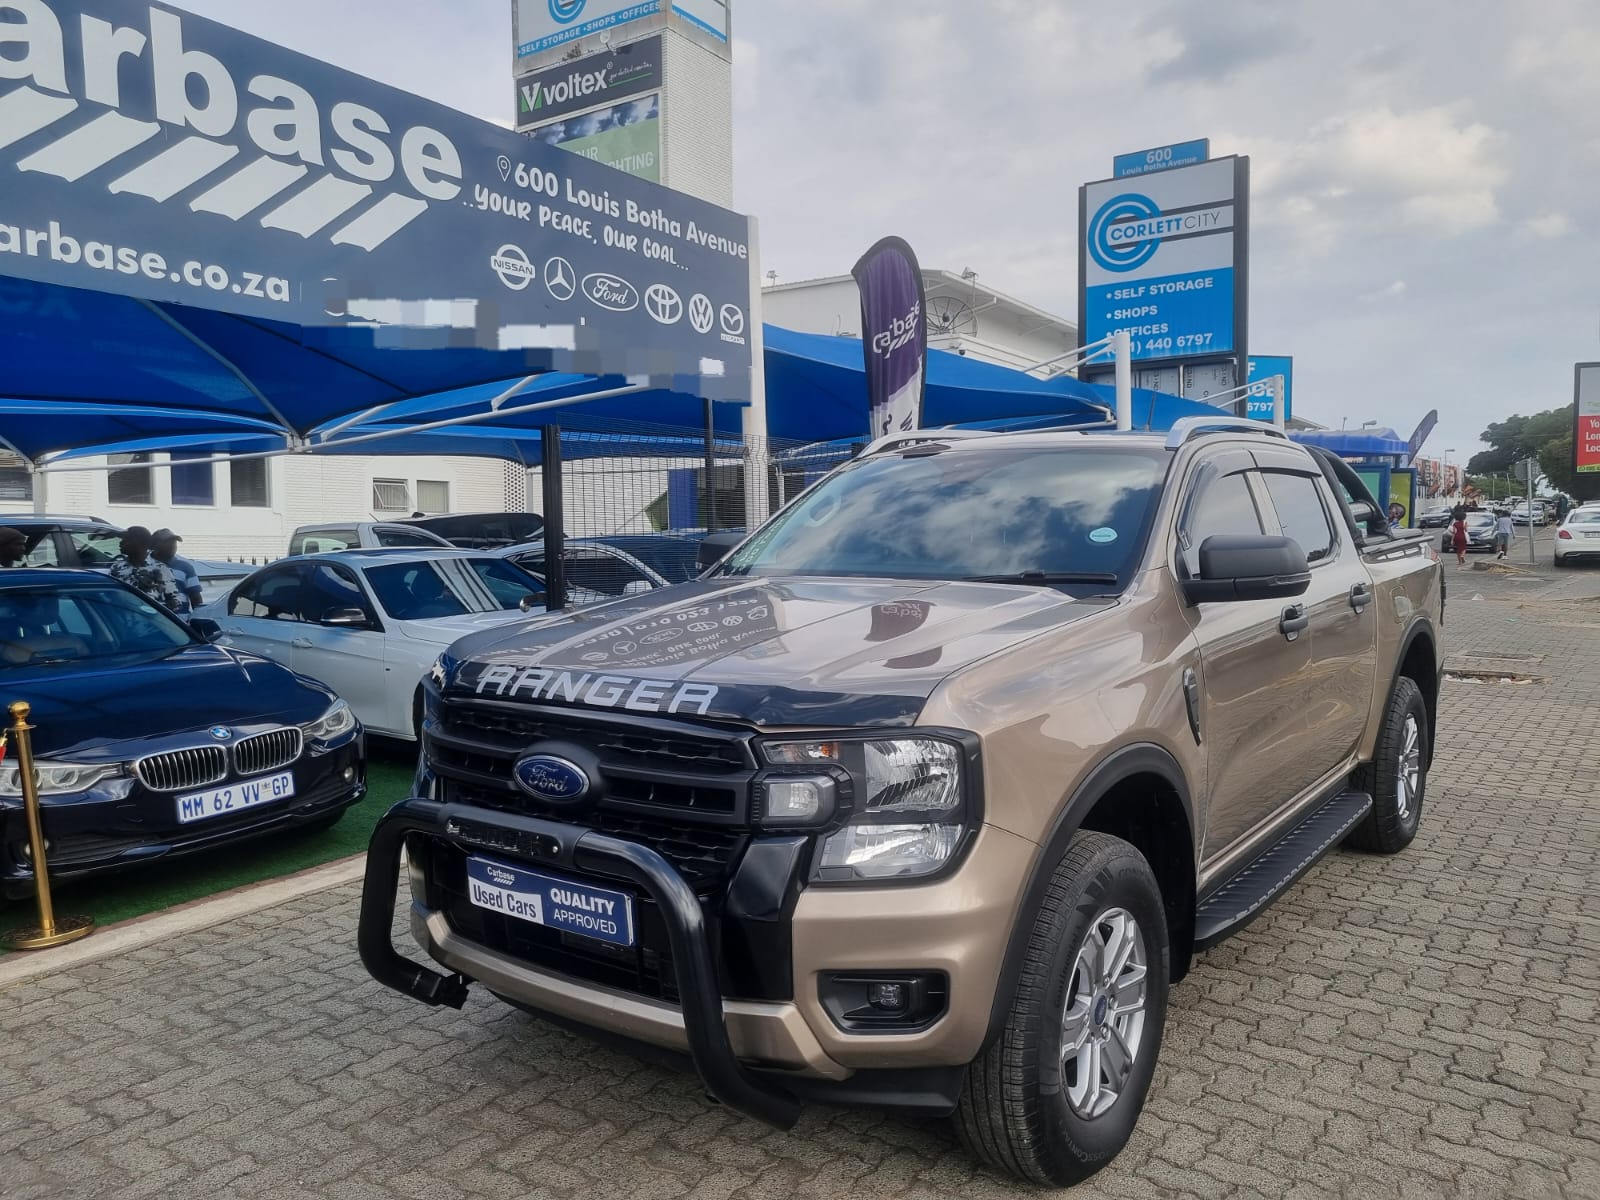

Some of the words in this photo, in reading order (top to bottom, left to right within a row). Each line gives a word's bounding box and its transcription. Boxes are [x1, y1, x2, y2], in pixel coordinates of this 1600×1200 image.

[521, 44, 540, 55] SELF
[543, 28, 580, 48] STORAGE
[586, 15, 616, 32] SHOPS
[622, 2, 660, 20] OFFICES
[543, 69, 608, 106] voltex
[1122, 167, 1142, 176] Louis
[1144, 163, 1166, 172] Botha
[1168, 156, 1198, 167] Avenue
[1146, 148, 1172, 164] 600
[514, 162, 559, 198] 600
[566, 178, 620, 219] Louis
[626, 200, 681, 238] Botha
[686, 221, 748, 260] Avenue
[539, 204, 598, 245] PEACE,
[603, 225, 638, 253] OUR
[492, 258, 534, 276] NISSAN
[593, 278, 629, 307] Ford
[1114, 286, 1145, 300] SELF
[1149, 277, 1213, 295] STORAGE
[1114, 305, 1158, 320] SHOPS
[1145, 337, 1172, 351] 440
[1176, 333, 1213, 347] 6797
[476, 665, 719, 715] RANGER
[528, 764, 568, 793] Ford
[182, 796, 204, 819] MM
[213, 790, 234, 811] 62
[242, 783, 260, 804] VV
[272, 775, 289, 796] GP
[487, 866, 516, 882] Carbase
[473, 883, 503, 913] Used
[507, 894, 537, 919] Cars
[550, 887, 615, 916] QUALITY
[554, 908, 617, 935] APPROVED
